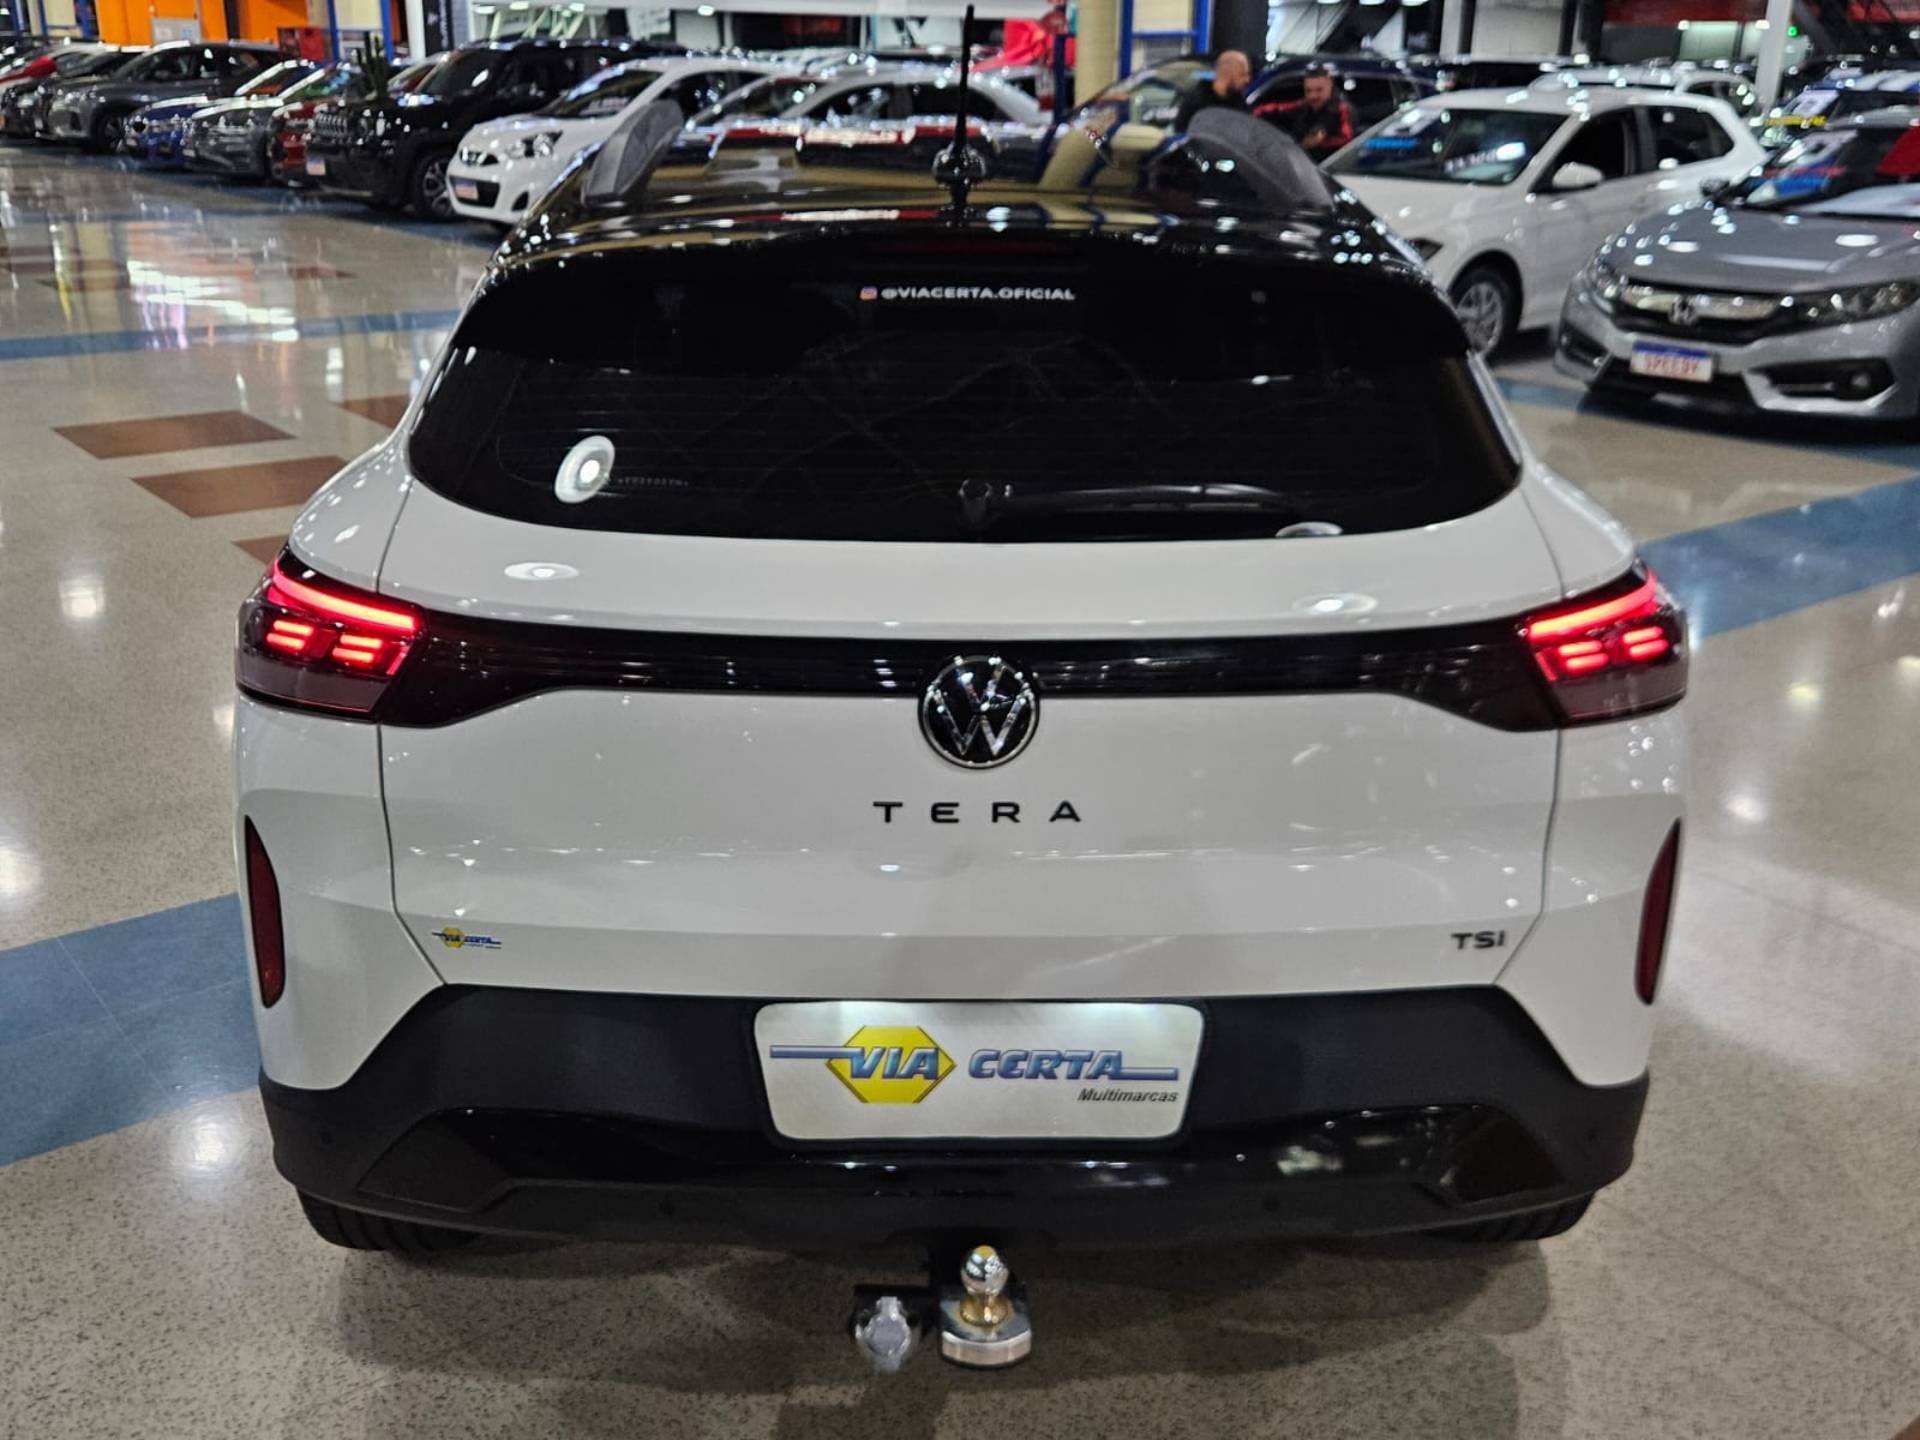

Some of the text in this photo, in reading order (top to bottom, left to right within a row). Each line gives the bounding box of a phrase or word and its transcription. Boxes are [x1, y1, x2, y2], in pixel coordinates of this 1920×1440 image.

[881, 286, 1076, 301] @VIACERTA.OFICIAL
[872, 800, 1083, 824] TERA
[850, 1046, 1123, 1081] VIA CERTA
[1077, 1087, 1179, 1103] Multimarcas
